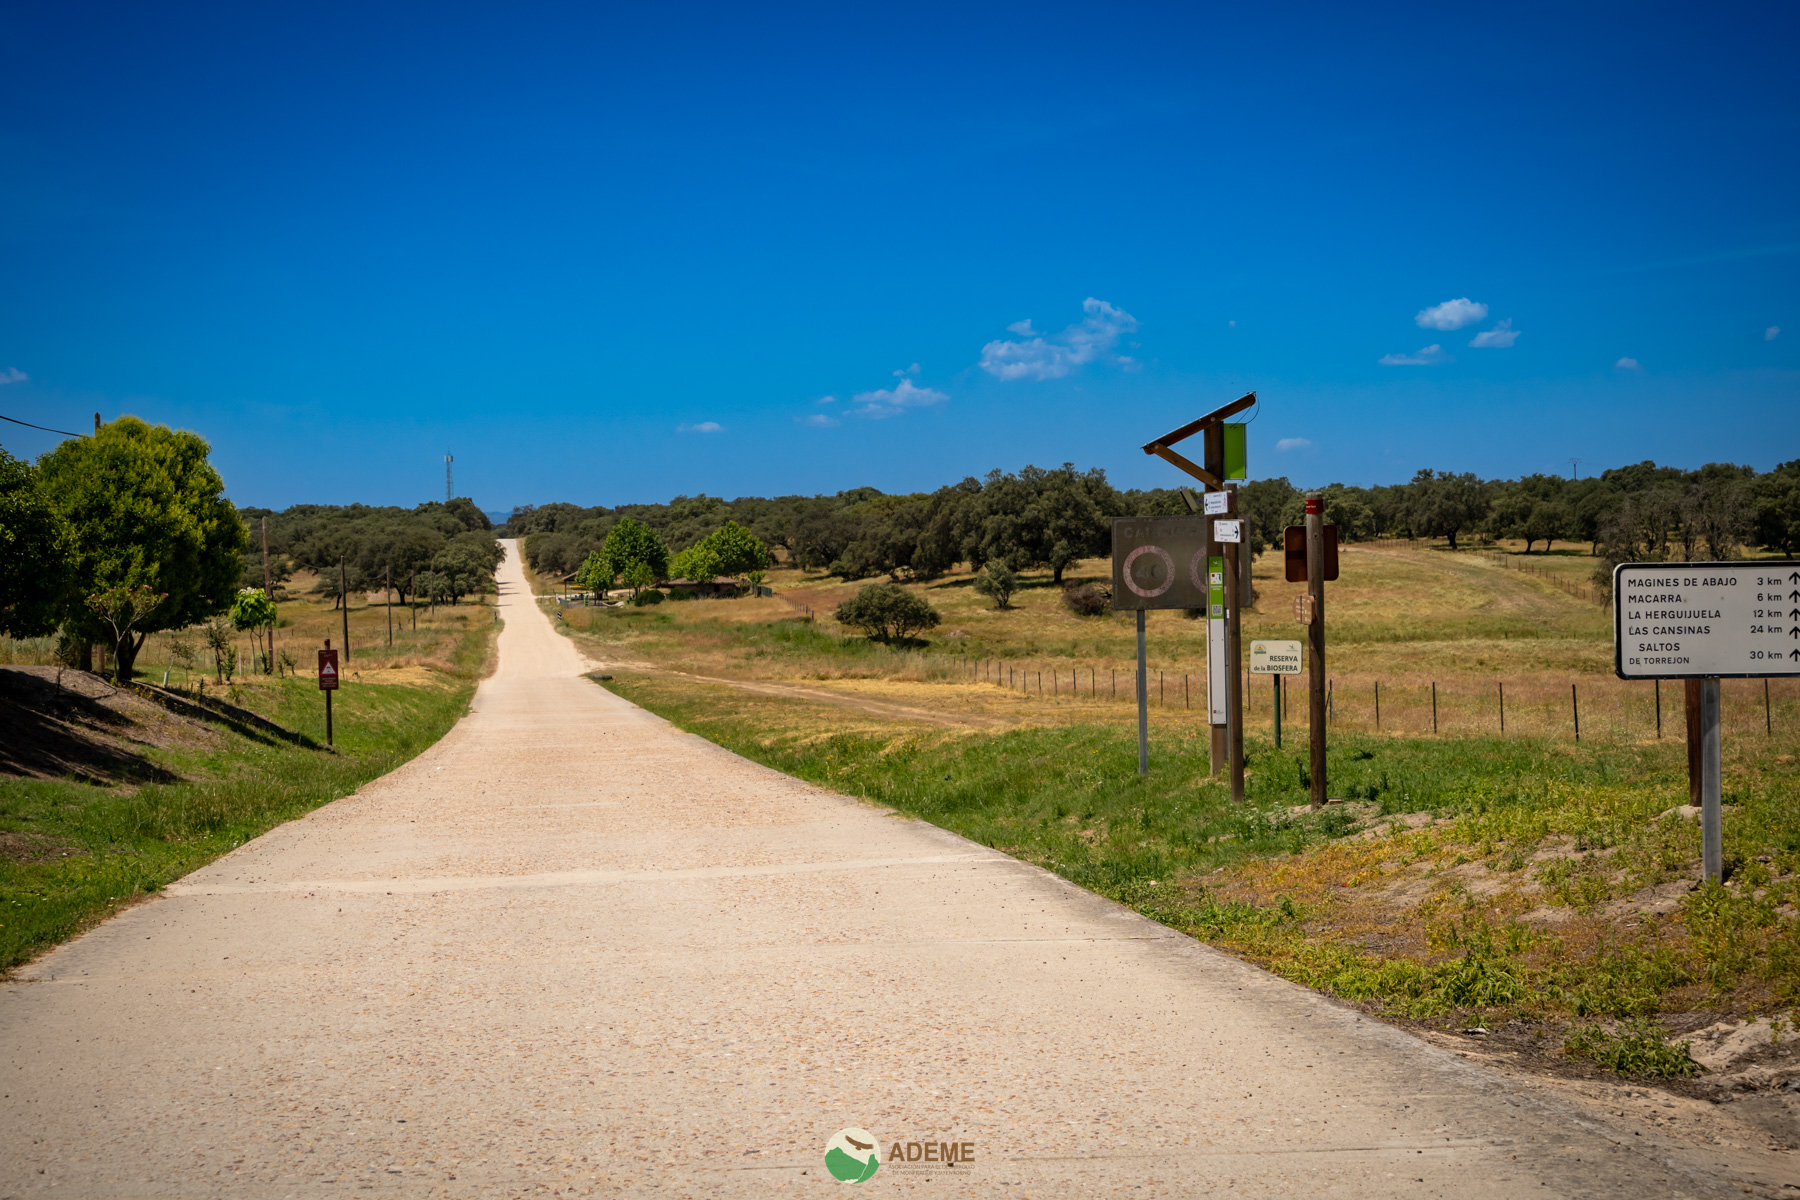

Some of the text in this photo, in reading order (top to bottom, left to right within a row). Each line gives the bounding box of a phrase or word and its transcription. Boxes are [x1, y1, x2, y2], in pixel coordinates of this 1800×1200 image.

[1628, 577, 1737, 587] MAGINES DE ABAJO
[1757, 577, 1782, 586] 3 km
[1628, 594, 1682, 603] MACARRA
[1757, 593, 1782, 601] 6 km
[1628, 610, 1721, 619] LA HERGUIJUELA
[1753, 609, 1782, 618] 12 km
[1629, 625, 1711, 635] LAS CANSINAS
[1750, 625, 1783, 634] 24 km
[1638, 643, 1680, 652] SALTOS
[1750, 651, 1783, 660] 30 km
[1629, 657, 1690, 665] DE TORREJON
